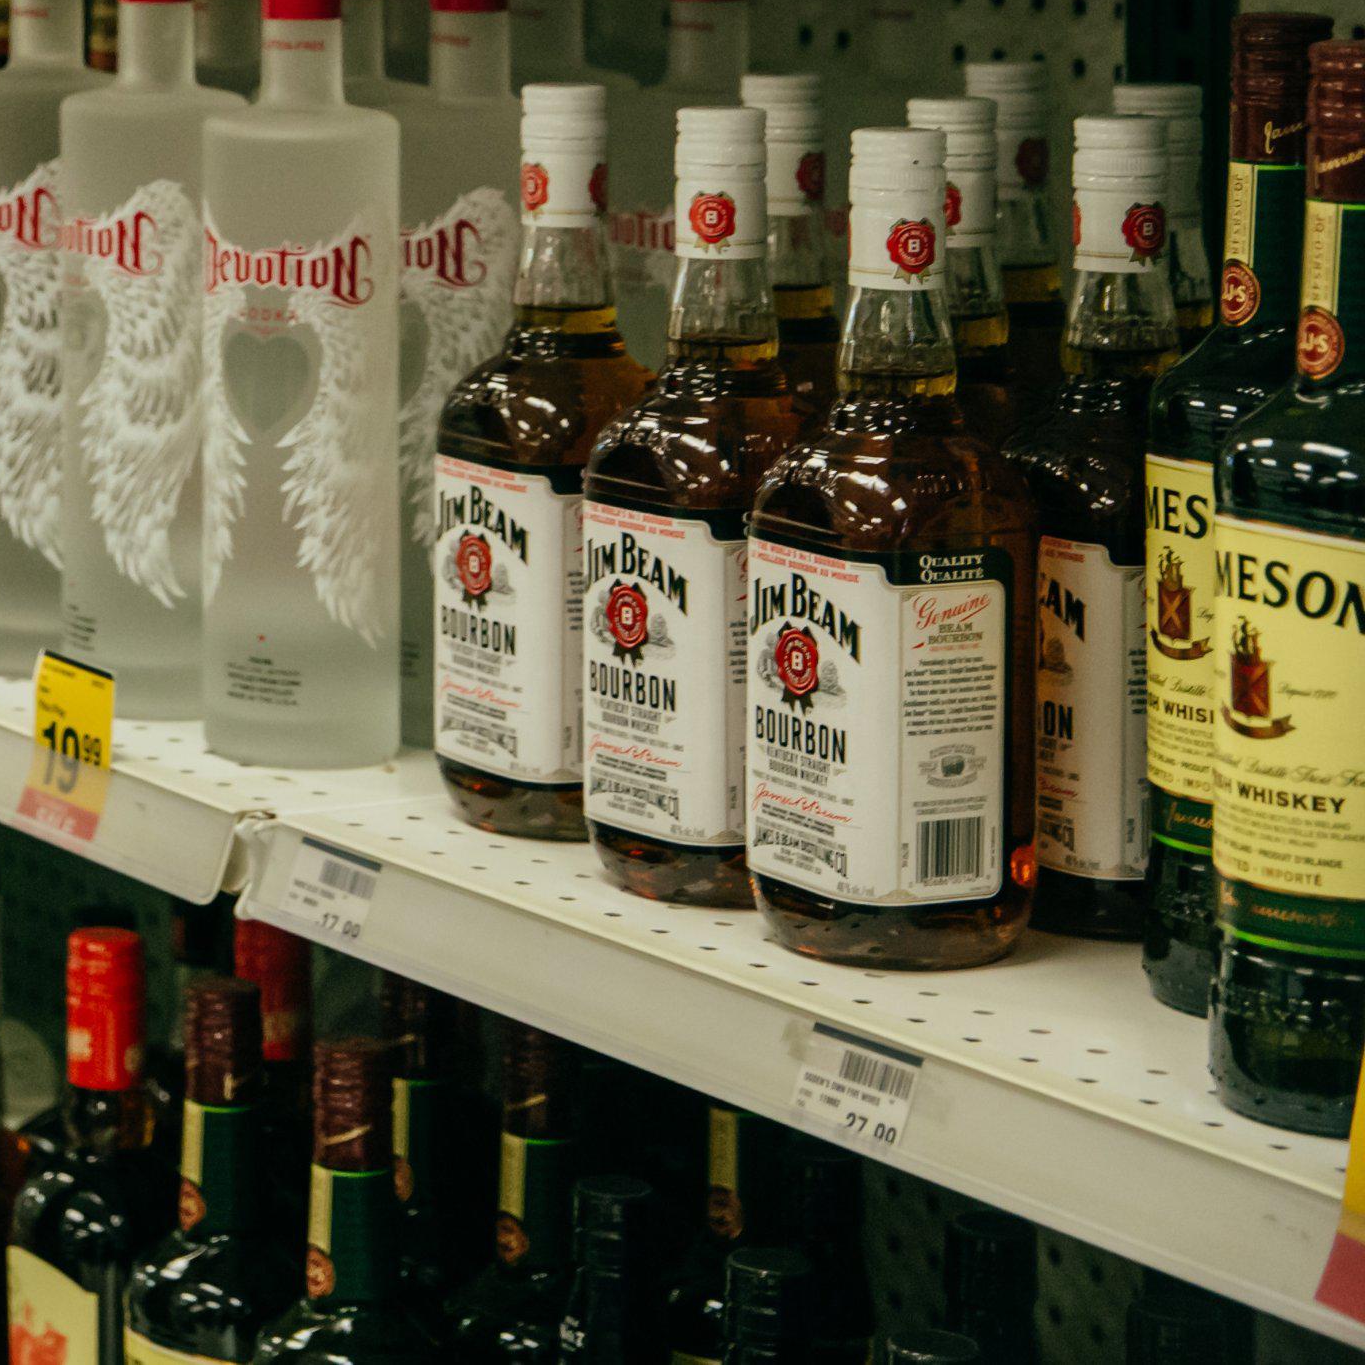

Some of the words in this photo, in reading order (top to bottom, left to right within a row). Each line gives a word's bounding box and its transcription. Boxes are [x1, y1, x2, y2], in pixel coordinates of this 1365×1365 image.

[437, 491, 466, 541] JIM
[470, 485, 529, 567] BEAM
[584, 538, 616, 591] JIM
[621, 532, 690, 616] BEAM
[919, 554, 984, 569] QUALITY
[920, 567, 984, 584] QUALITÉ
[912, 593, 991, 630] Genuine
[1042, 576, 1086, 642] AM
[1214, 550, 1365, 635] MESON
[442, 605, 516, 656] BOURBON
[750, 577, 787, 636] JIM
[790, 572, 862, 665] BEAM
[928, 632, 983, 645] BOURBON
[938, 622, 973, 634] BEAM
[590, 660, 676, 712] BOURBON
[756, 705, 847, 764] BOURBON
[1236, 781, 1346, 814] WHISKEY
